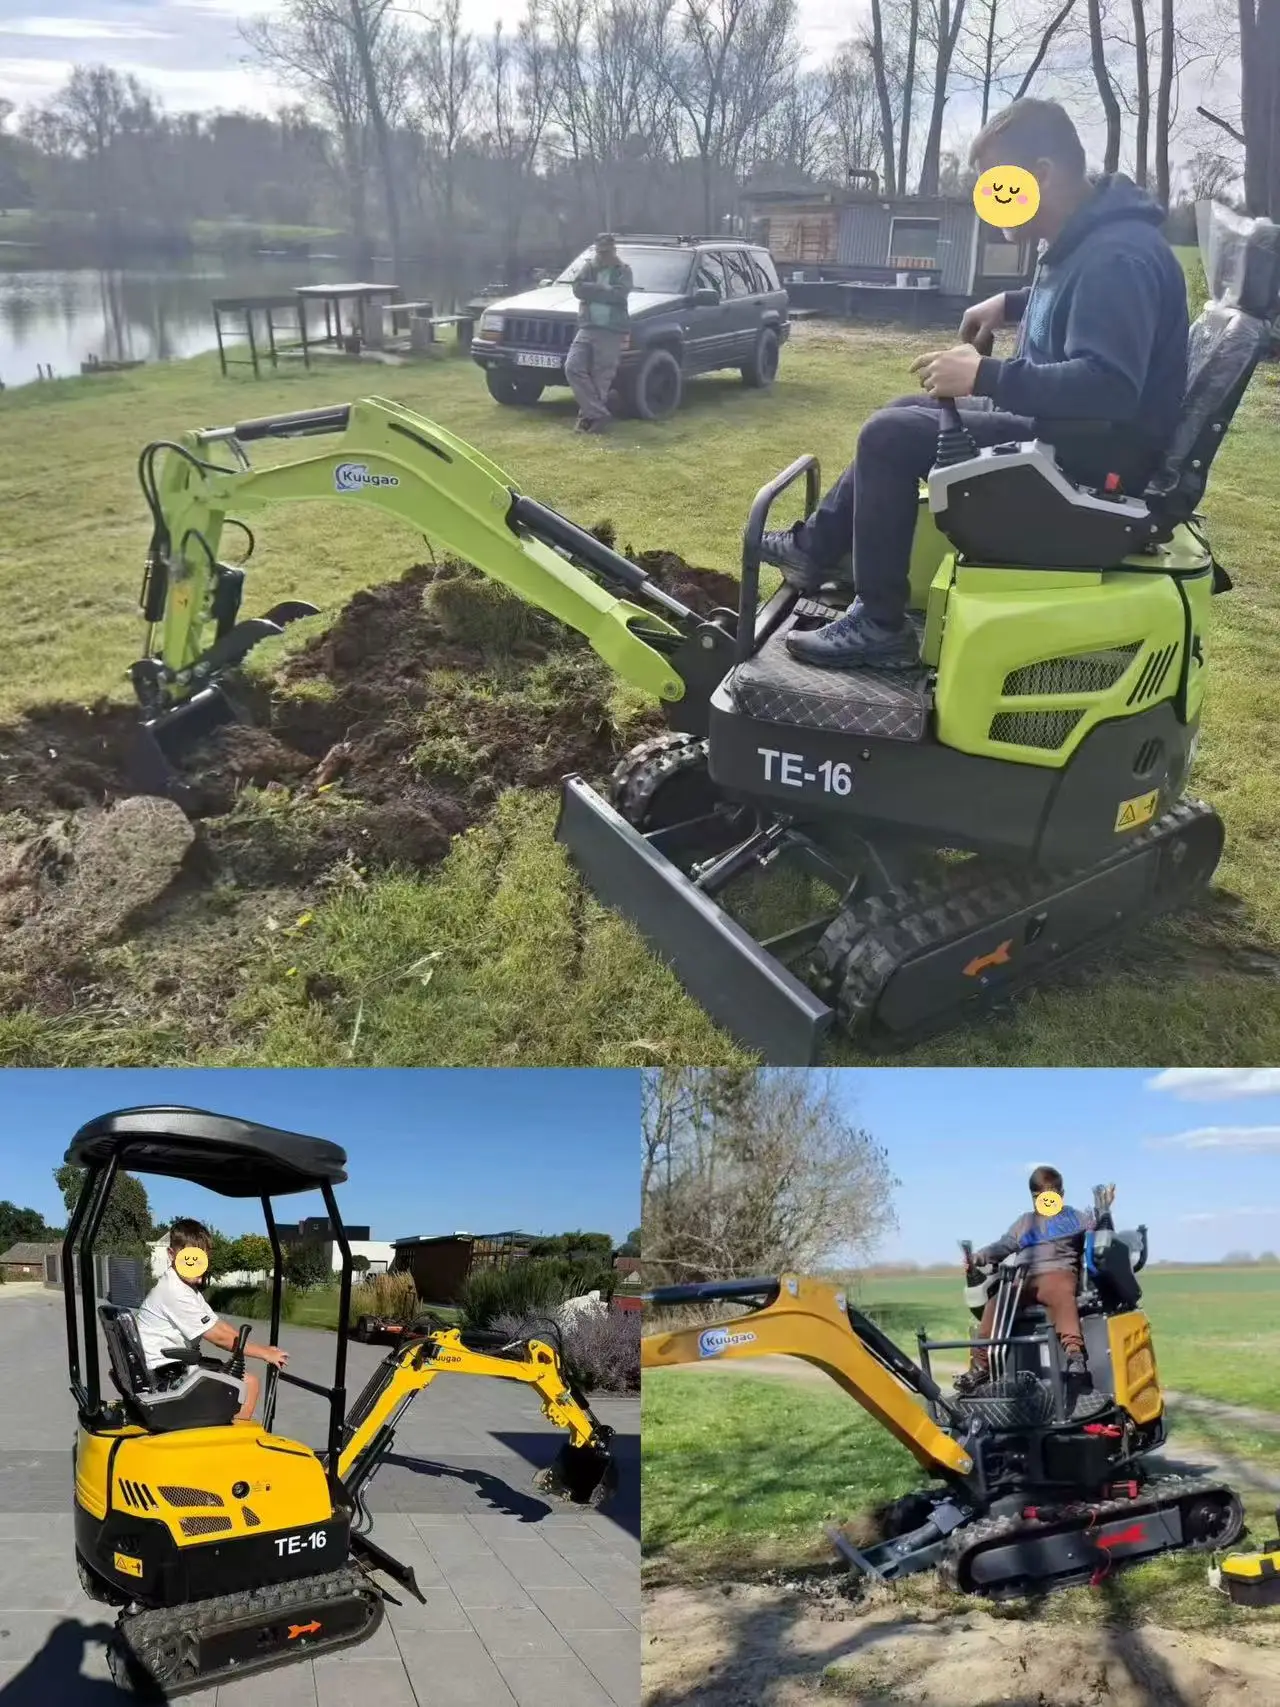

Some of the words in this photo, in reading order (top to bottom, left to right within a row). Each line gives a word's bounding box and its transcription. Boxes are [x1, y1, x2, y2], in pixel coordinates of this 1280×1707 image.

[343, 471, 399, 485] Kuugao
[757, 748, 852, 796] TE-16
[706, 1333, 754, 1346] Kuugao
[430, 1355, 462, 1363] uugao
[274, 1530, 327, 1556] TE-16
